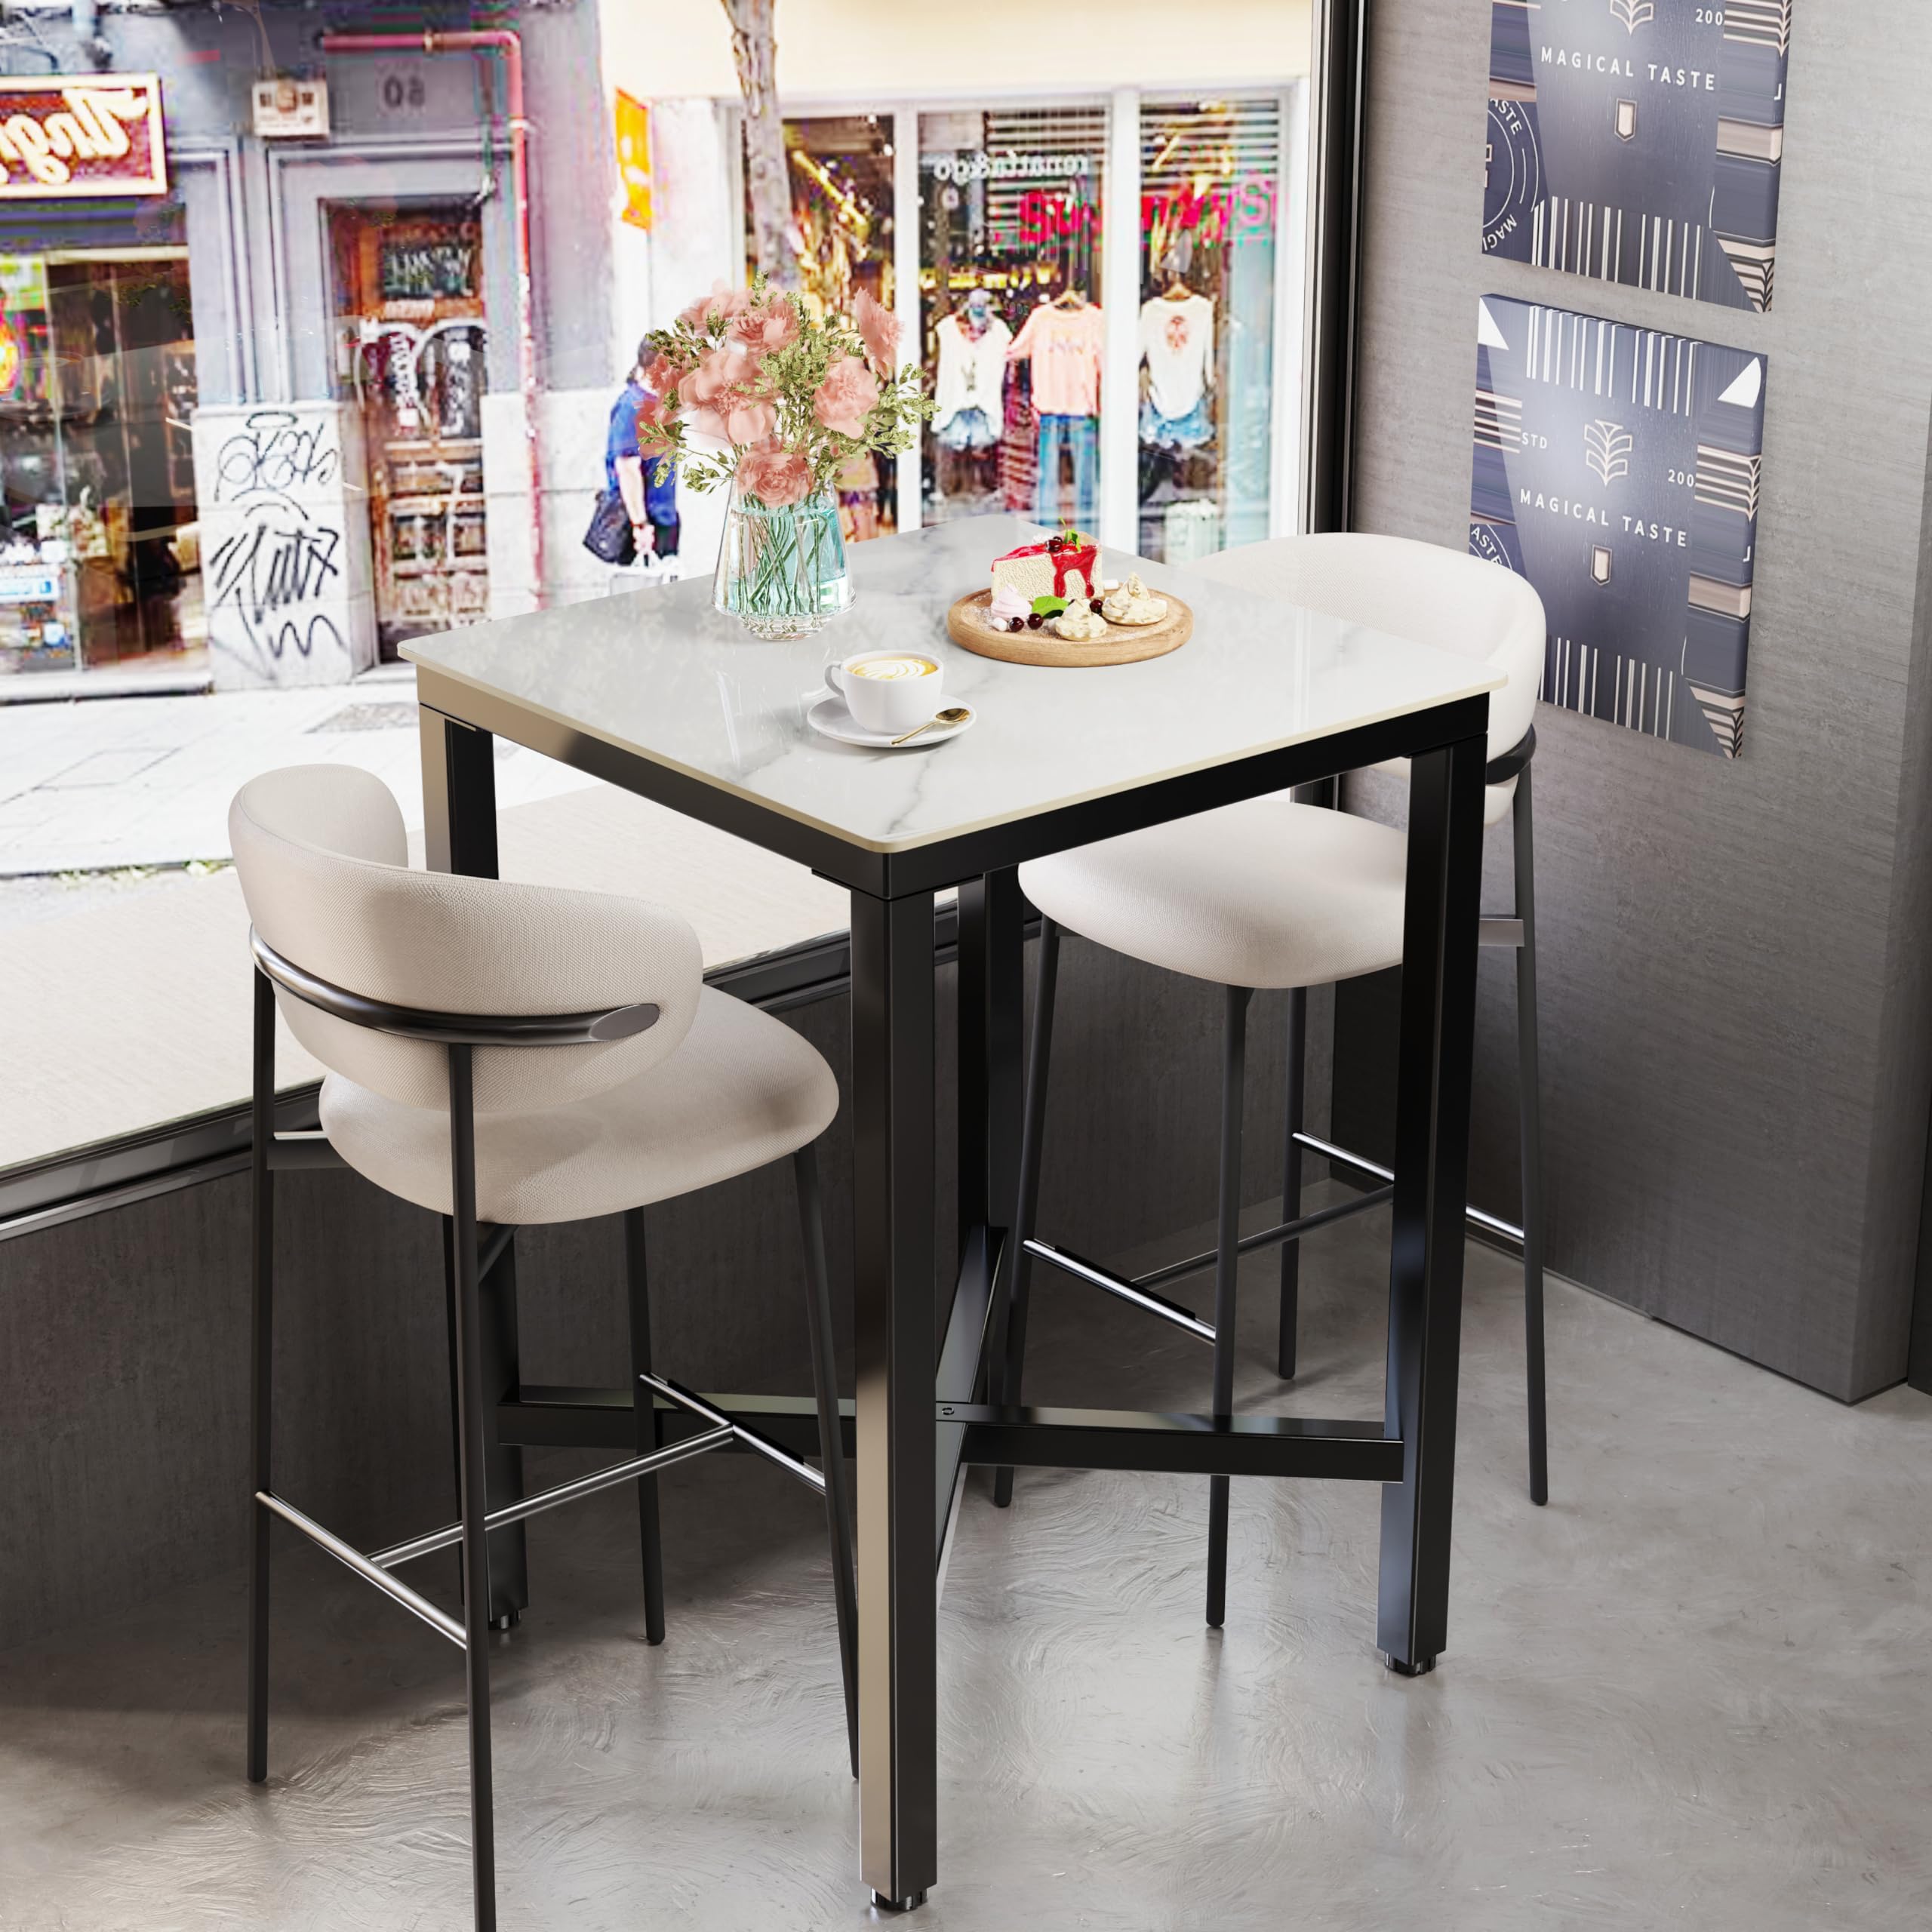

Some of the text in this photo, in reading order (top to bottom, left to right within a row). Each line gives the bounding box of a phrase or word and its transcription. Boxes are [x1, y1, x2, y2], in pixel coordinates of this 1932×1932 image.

[1541, 46, 1715, 91] MAGICAL TASTE
[1521, 432, 1548, 449] STD
[1520, 488, 1687, 547] MAGICAL TASTE
